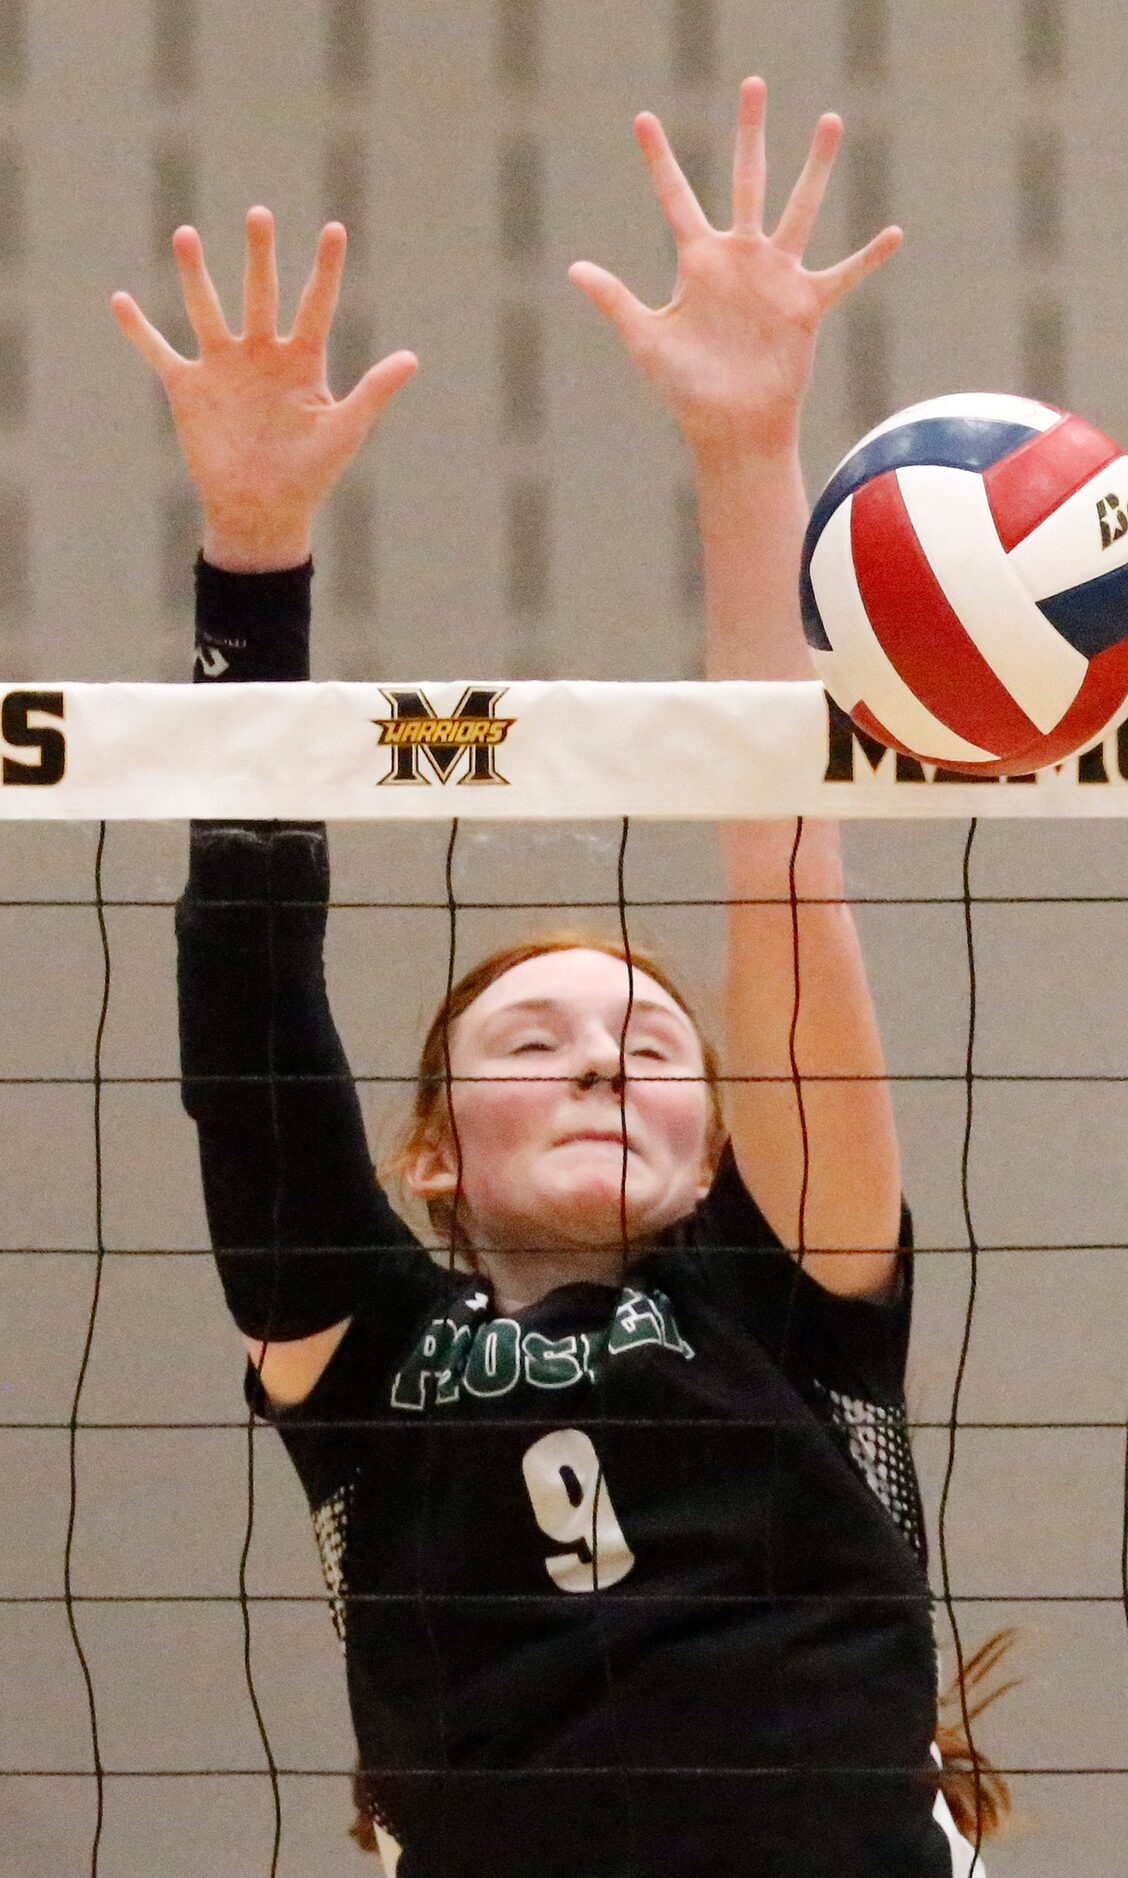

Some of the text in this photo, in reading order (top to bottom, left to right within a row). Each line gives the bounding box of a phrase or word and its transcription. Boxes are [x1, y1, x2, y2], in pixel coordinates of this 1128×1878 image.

[376, 686, 511, 786] M
[383, 720, 509, 743] WARRIORS
[522, 1428, 636, 1593] 9
